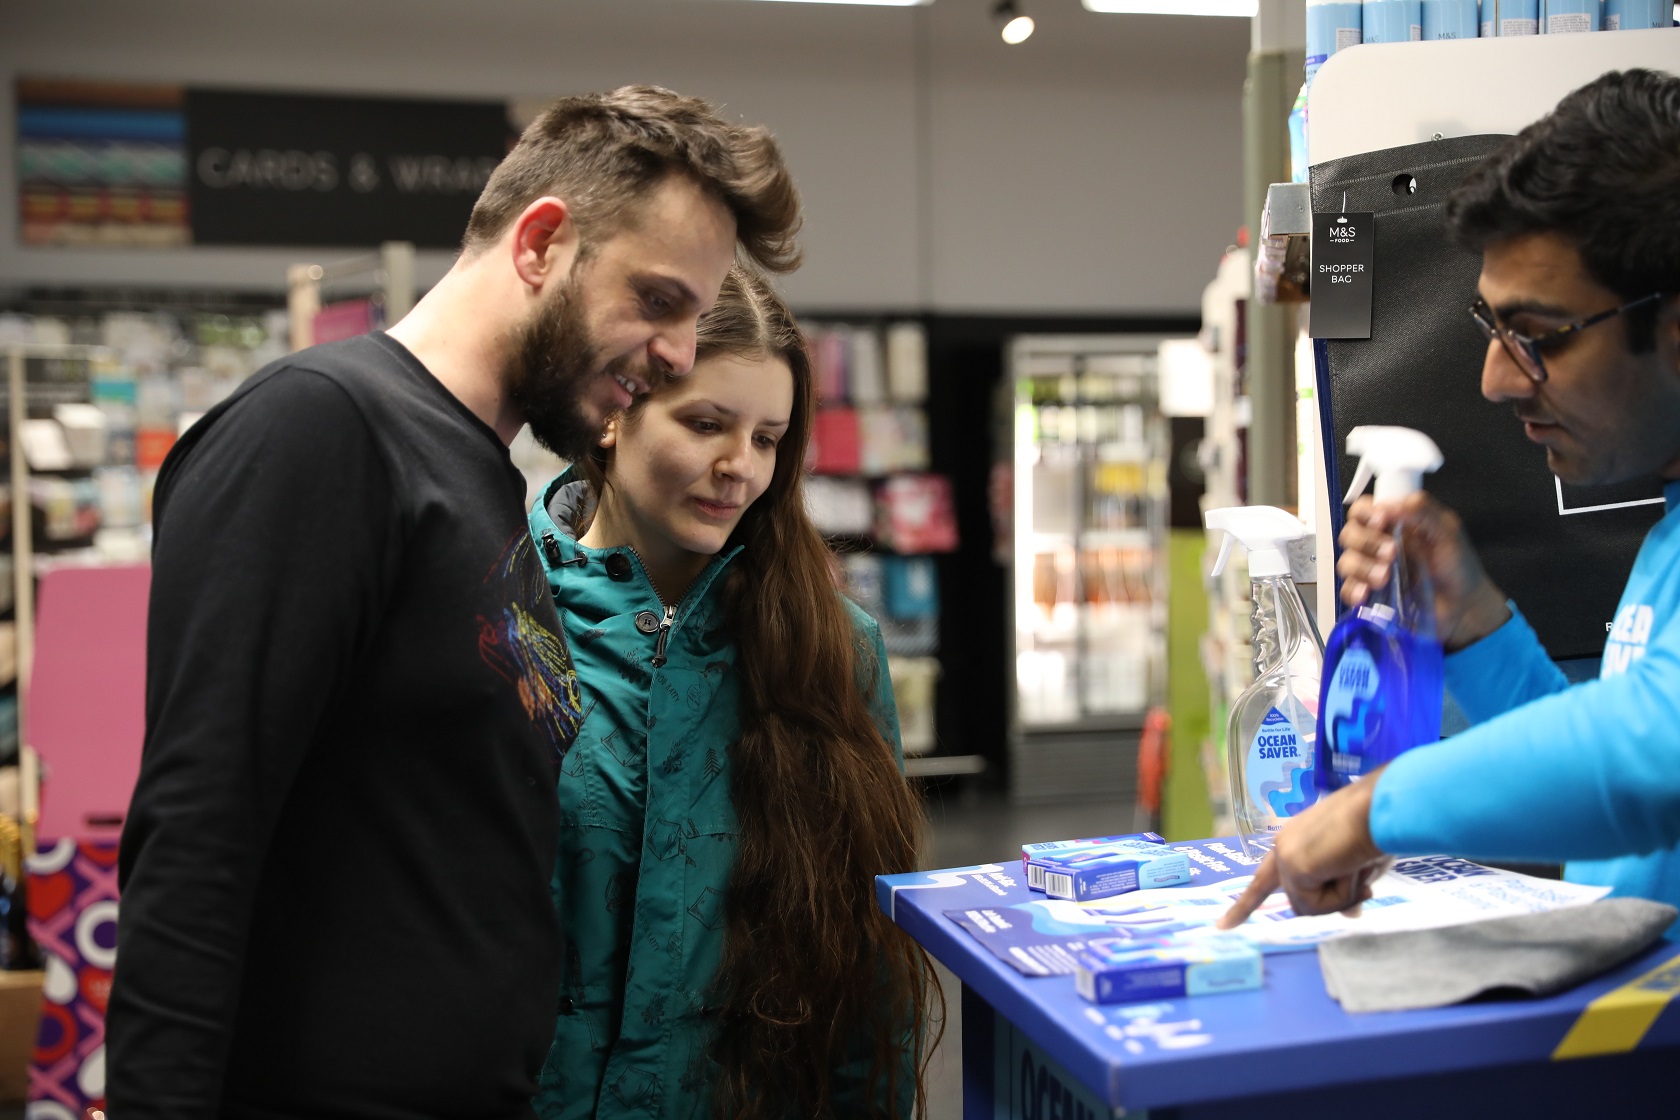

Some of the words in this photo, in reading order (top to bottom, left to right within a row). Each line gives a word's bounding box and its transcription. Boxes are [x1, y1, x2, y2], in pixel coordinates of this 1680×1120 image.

[1438, 32, 1456, 40] M&S
[197, 147, 339, 189] CARDS
[349, 152, 379, 192] &
[1329, 226, 1356, 238] M&S
[1319, 264, 1364, 273] SHOPPER
[1331, 275, 1352, 284] BAG
[1257, 734, 1297, 748] OCEAN
[1258, 746, 1298, 760] SAVER
